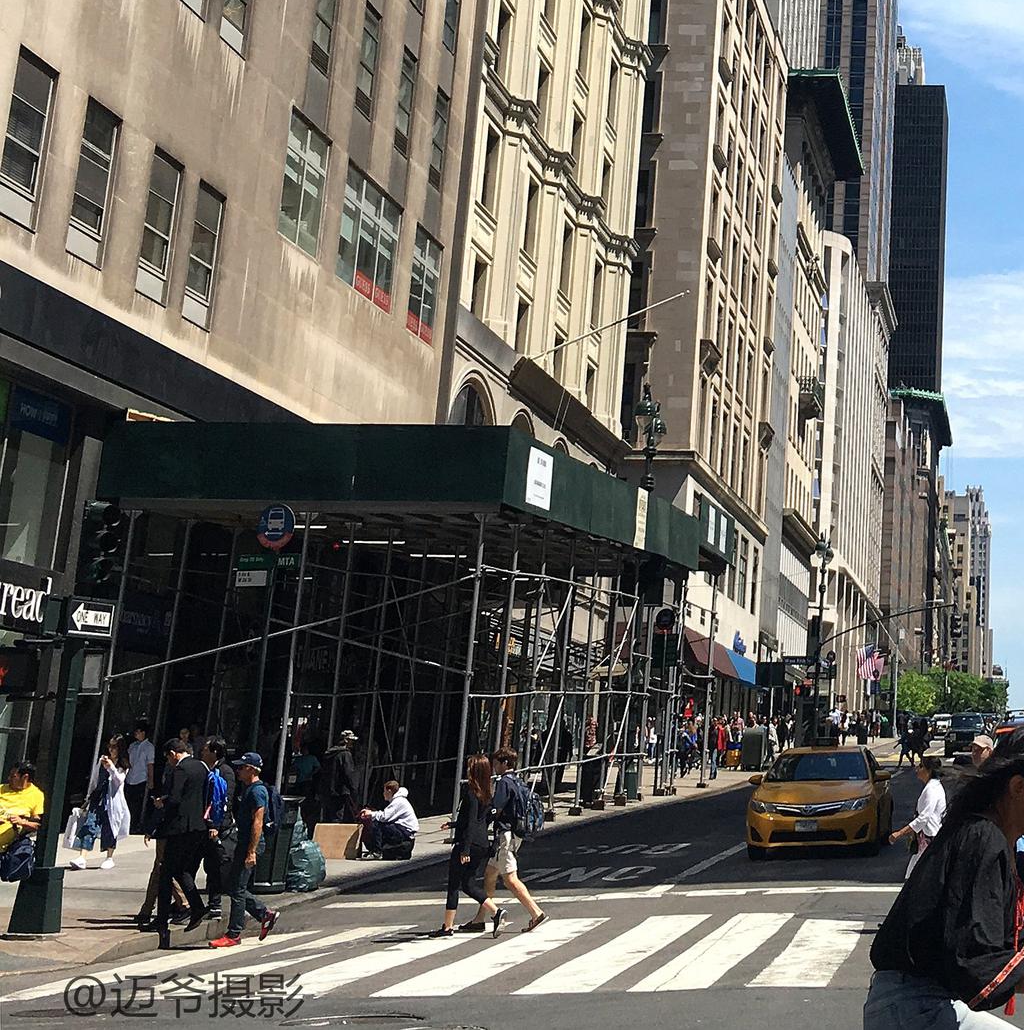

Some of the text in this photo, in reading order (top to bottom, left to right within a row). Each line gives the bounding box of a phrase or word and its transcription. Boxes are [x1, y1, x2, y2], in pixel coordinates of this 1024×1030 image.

[277, 557, 295, 566] MTA
[76, 609, 89, 624] ONE
[93, 611, 107, 624] WAY
